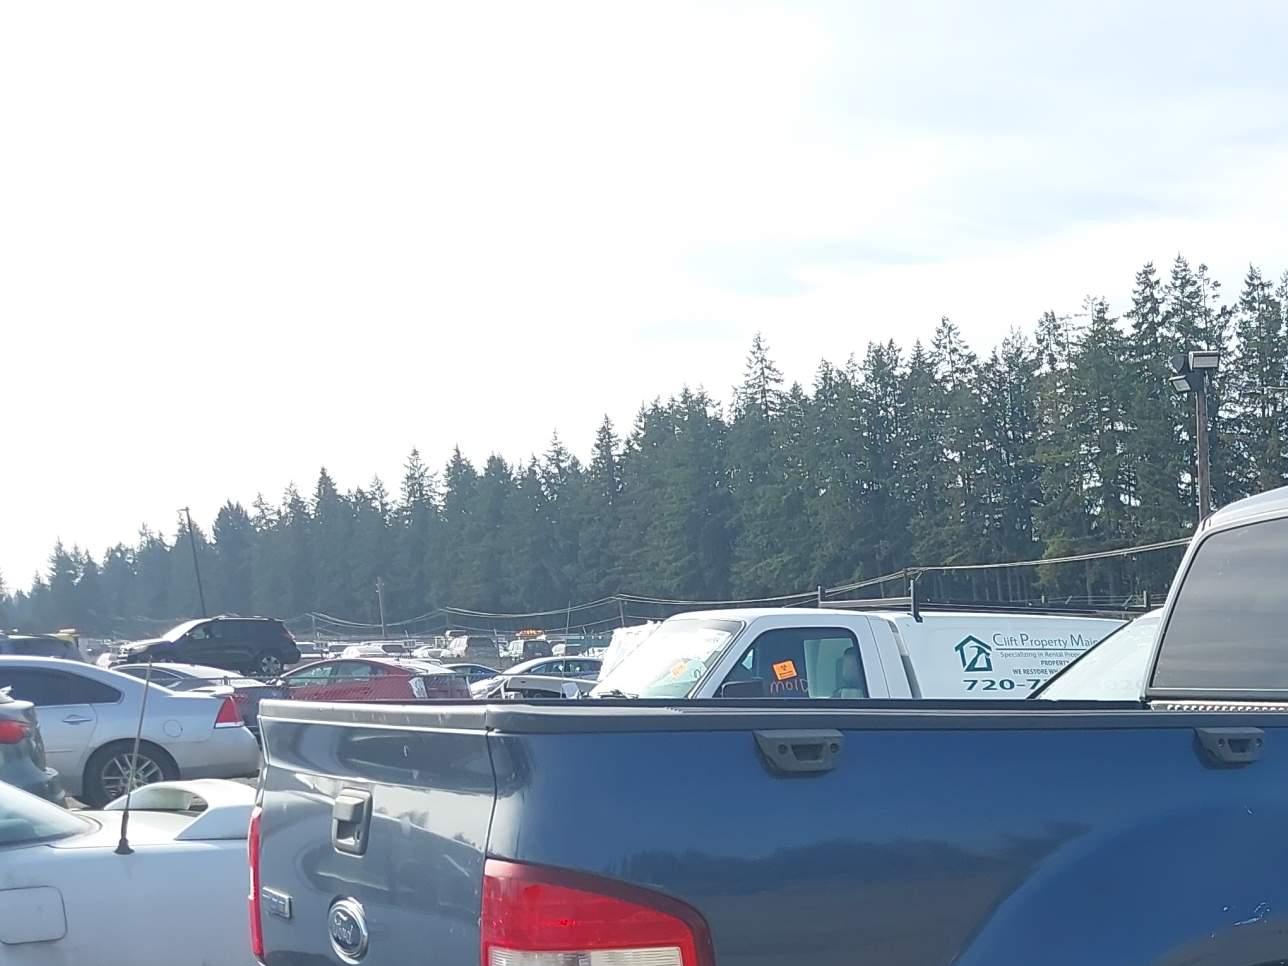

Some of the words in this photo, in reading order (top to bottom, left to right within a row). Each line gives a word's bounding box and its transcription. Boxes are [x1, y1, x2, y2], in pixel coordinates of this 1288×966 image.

[993, 633, 1018, 646] Clift
[1020, 633, 1067, 648] Property
[1000, 651, 1037, 659] Specializing
[963, 679, 1048, 691] 720-7
